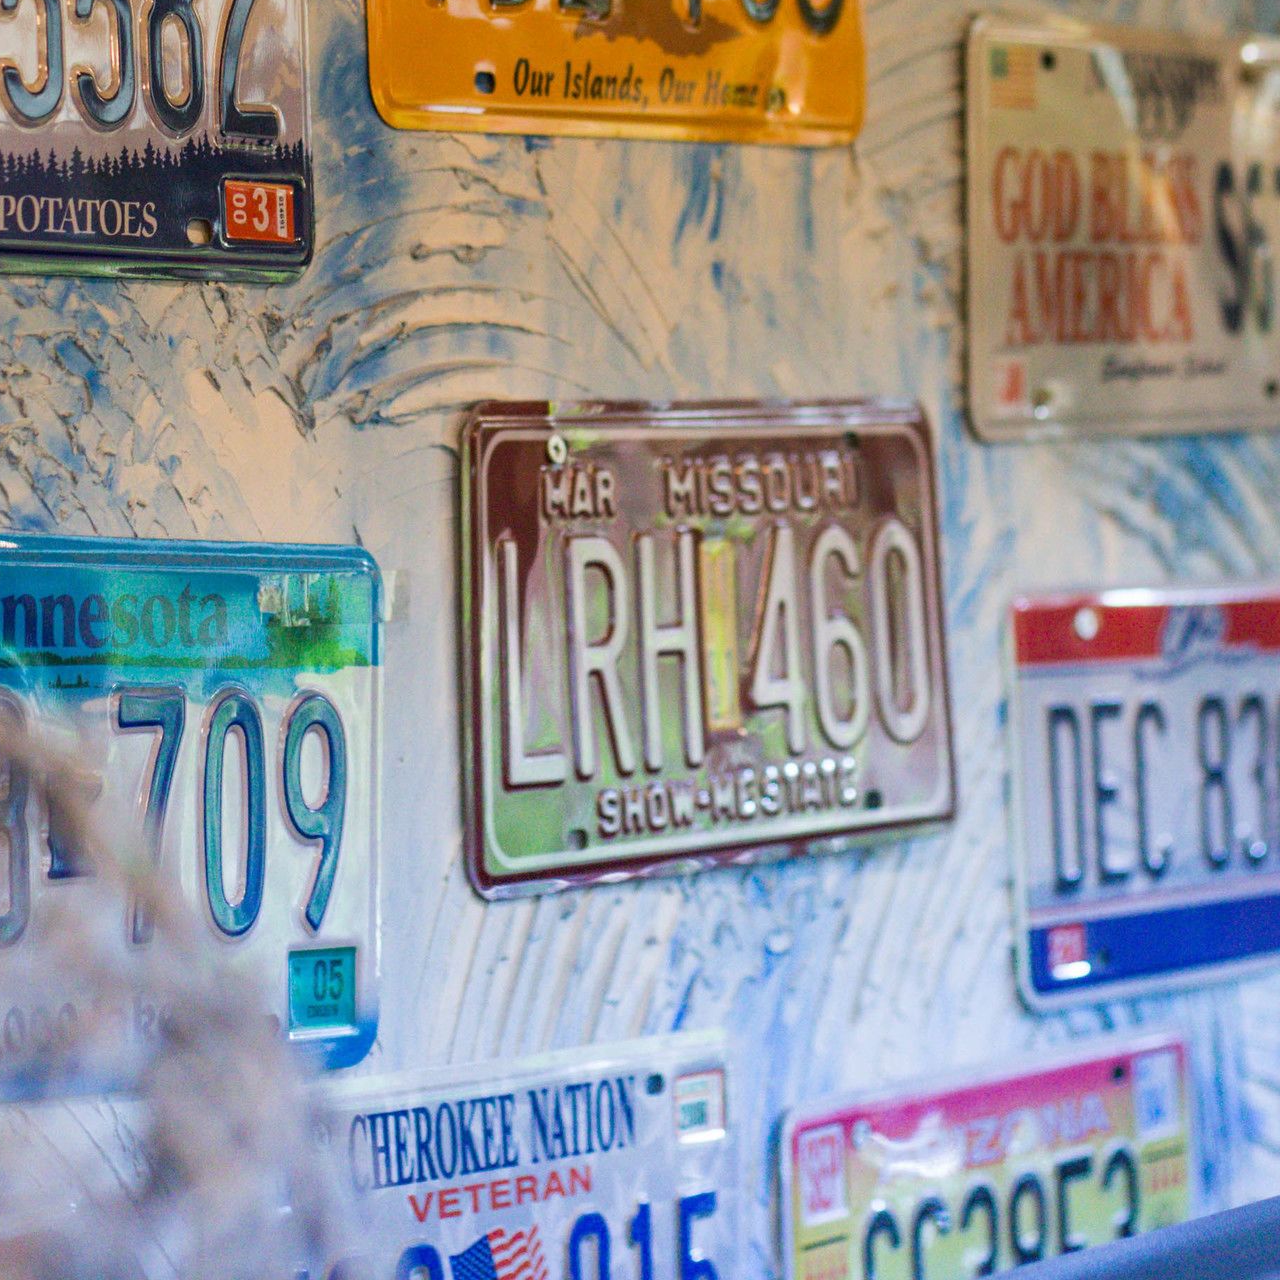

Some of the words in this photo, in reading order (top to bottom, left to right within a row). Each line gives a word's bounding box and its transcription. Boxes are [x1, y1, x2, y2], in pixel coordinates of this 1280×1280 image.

[513, 56, 556, 98] Our
[562, 60, 651, 112] Islands,
[658, 64, 698, 105] Our
[252, 187, 271, 232] 3
[992, 144, 1082, 247] GOD
[541, 464, 617, 519] MAR
[661, 450, 862, 517] MISSOURI
[501, 523, 706, 791] LRH
[751, 520, 931, 755] 460
[119, 689, 347, 945] 709
[1047, 701, 1173, 895] DEC
[313, 959, 345, 1002] 05
[349, 1093, 519, 1194] CHEROKEE
[527, 1074, 638, 1175] NATION
[407, 1165, 593, 1224] VETERAN
